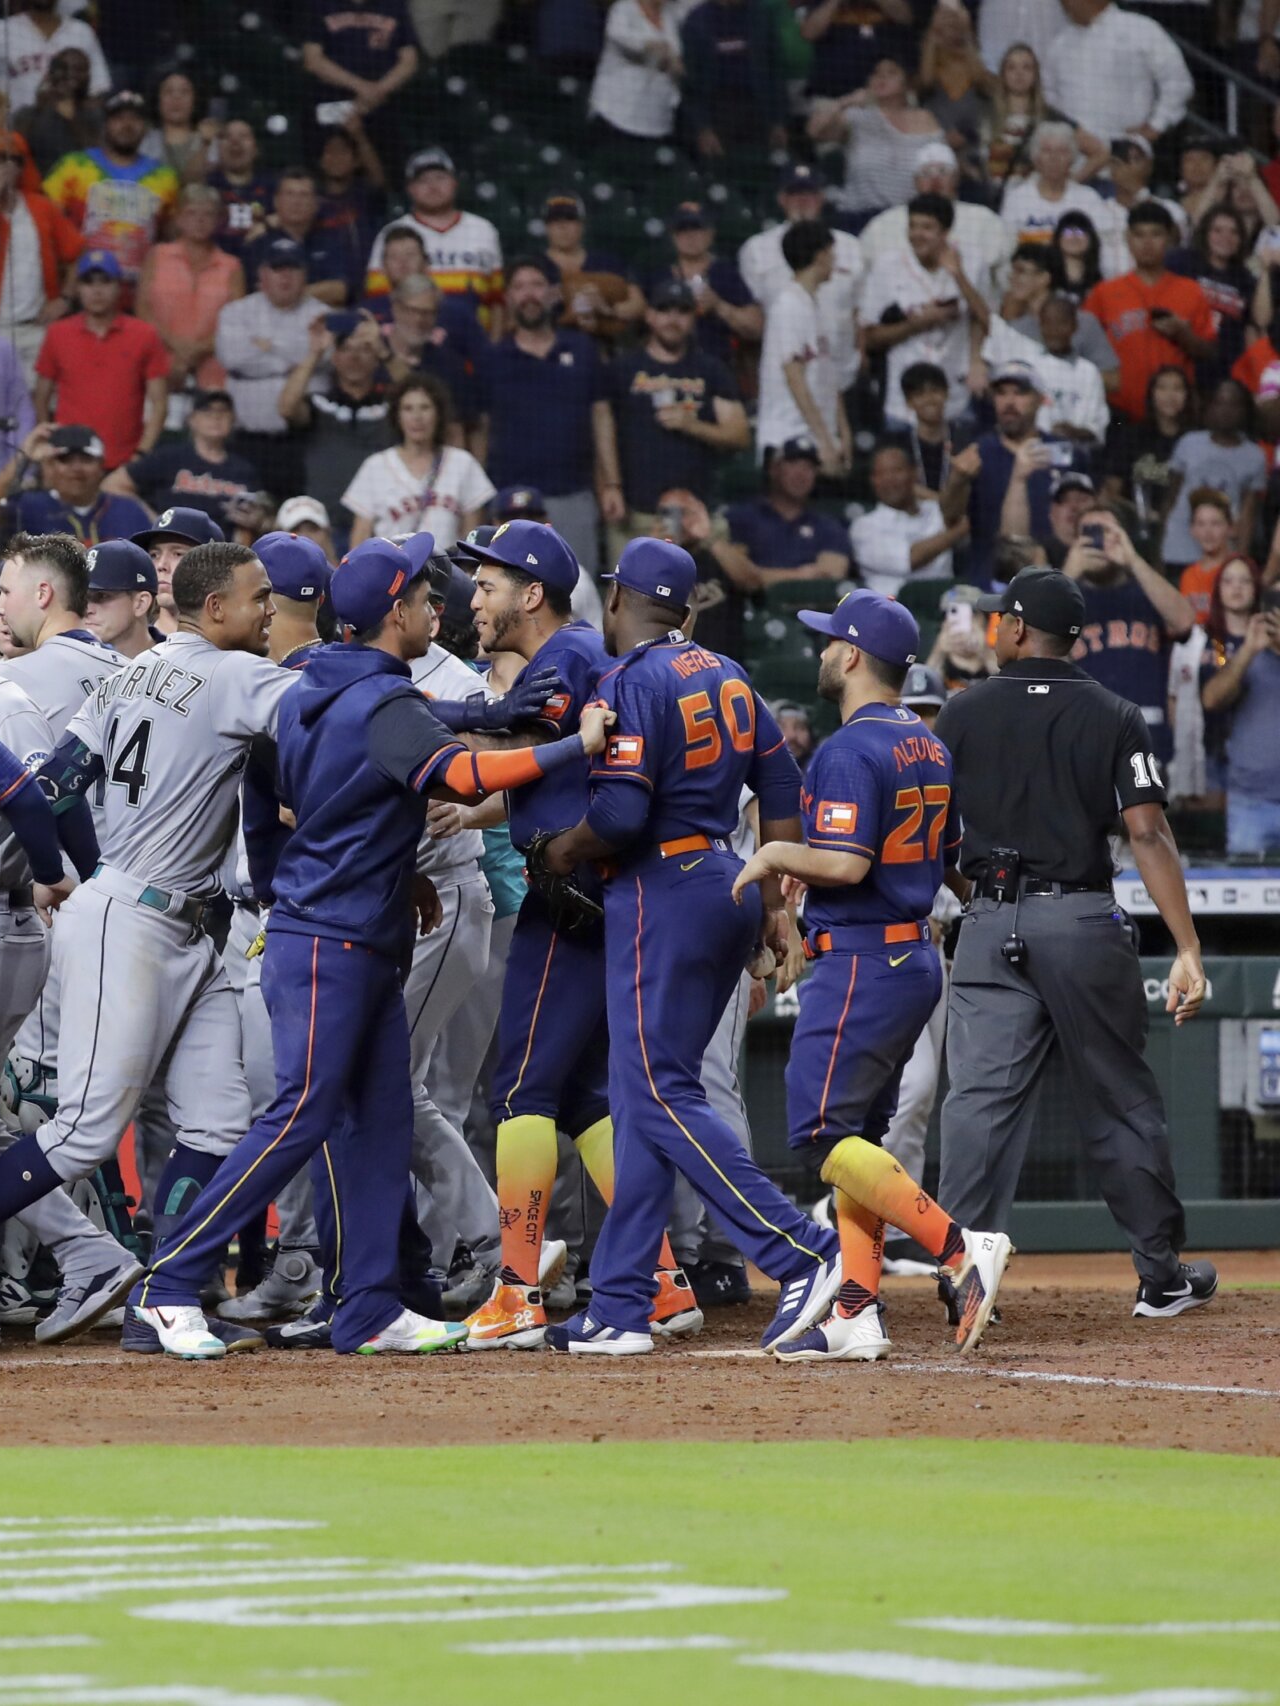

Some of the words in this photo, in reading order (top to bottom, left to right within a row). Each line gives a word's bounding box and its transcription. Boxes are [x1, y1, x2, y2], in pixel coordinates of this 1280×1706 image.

[670, 649, 721, 679] NERIS
[677, 677, 756, 771] 50
[893, 736, 945, 773] ALTUVE
[880, 784, 951, 865] 27
[527, 1189, 542, 1221] SPACE
[525, 1222, 537, 1246] CITY
[874, 1217, 885, 1242] PACE
[982, 1237, 994, 1251] 27
[514, 1310, 535, 1327] 22
